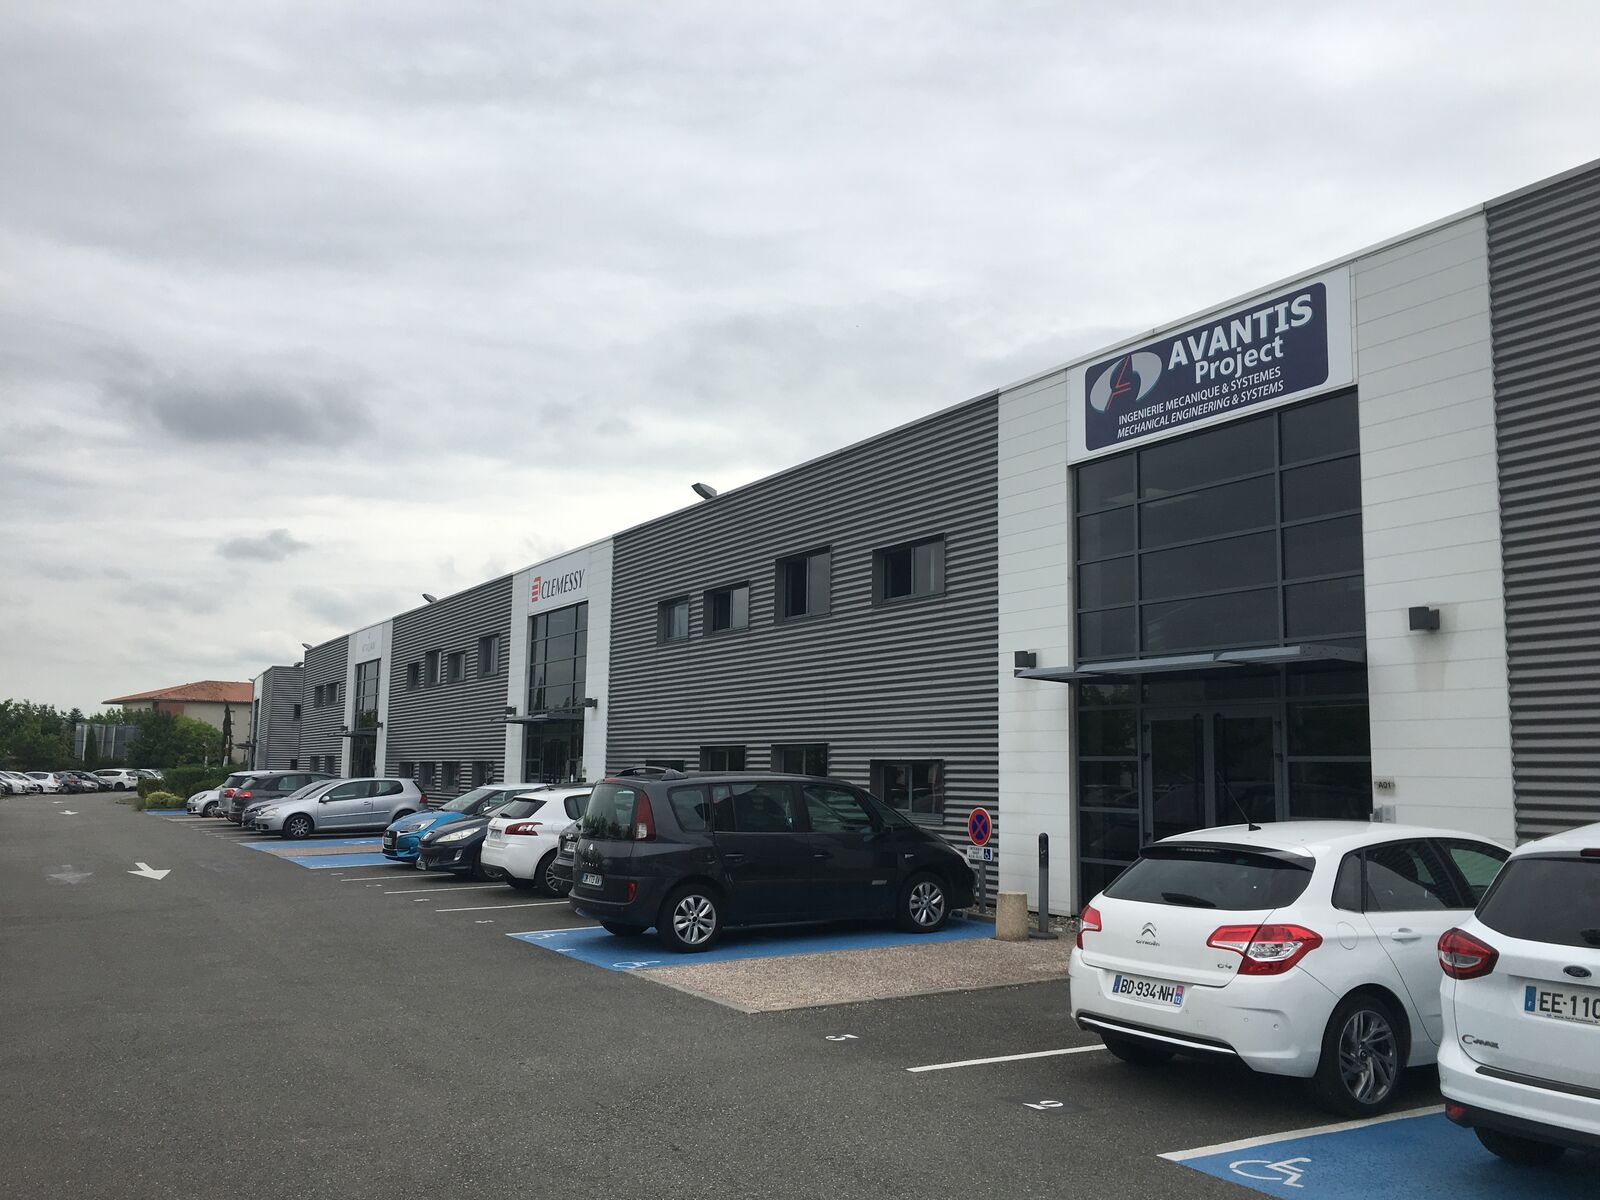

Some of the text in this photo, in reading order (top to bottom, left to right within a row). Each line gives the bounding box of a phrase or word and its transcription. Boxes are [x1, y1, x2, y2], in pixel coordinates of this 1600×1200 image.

[1168, 294, 1312, 370] AVANTIS
[1196, 336, 1284, 384] Project
[1117, 380, 1284, 439] MECHANICAL ENGINEERING & SYSTEMS
[1118, 366, 1281, 426] INGENIERIE MECANIQUE & SYSTEMES
[541, 569, 585, 600] CLEMESSY
